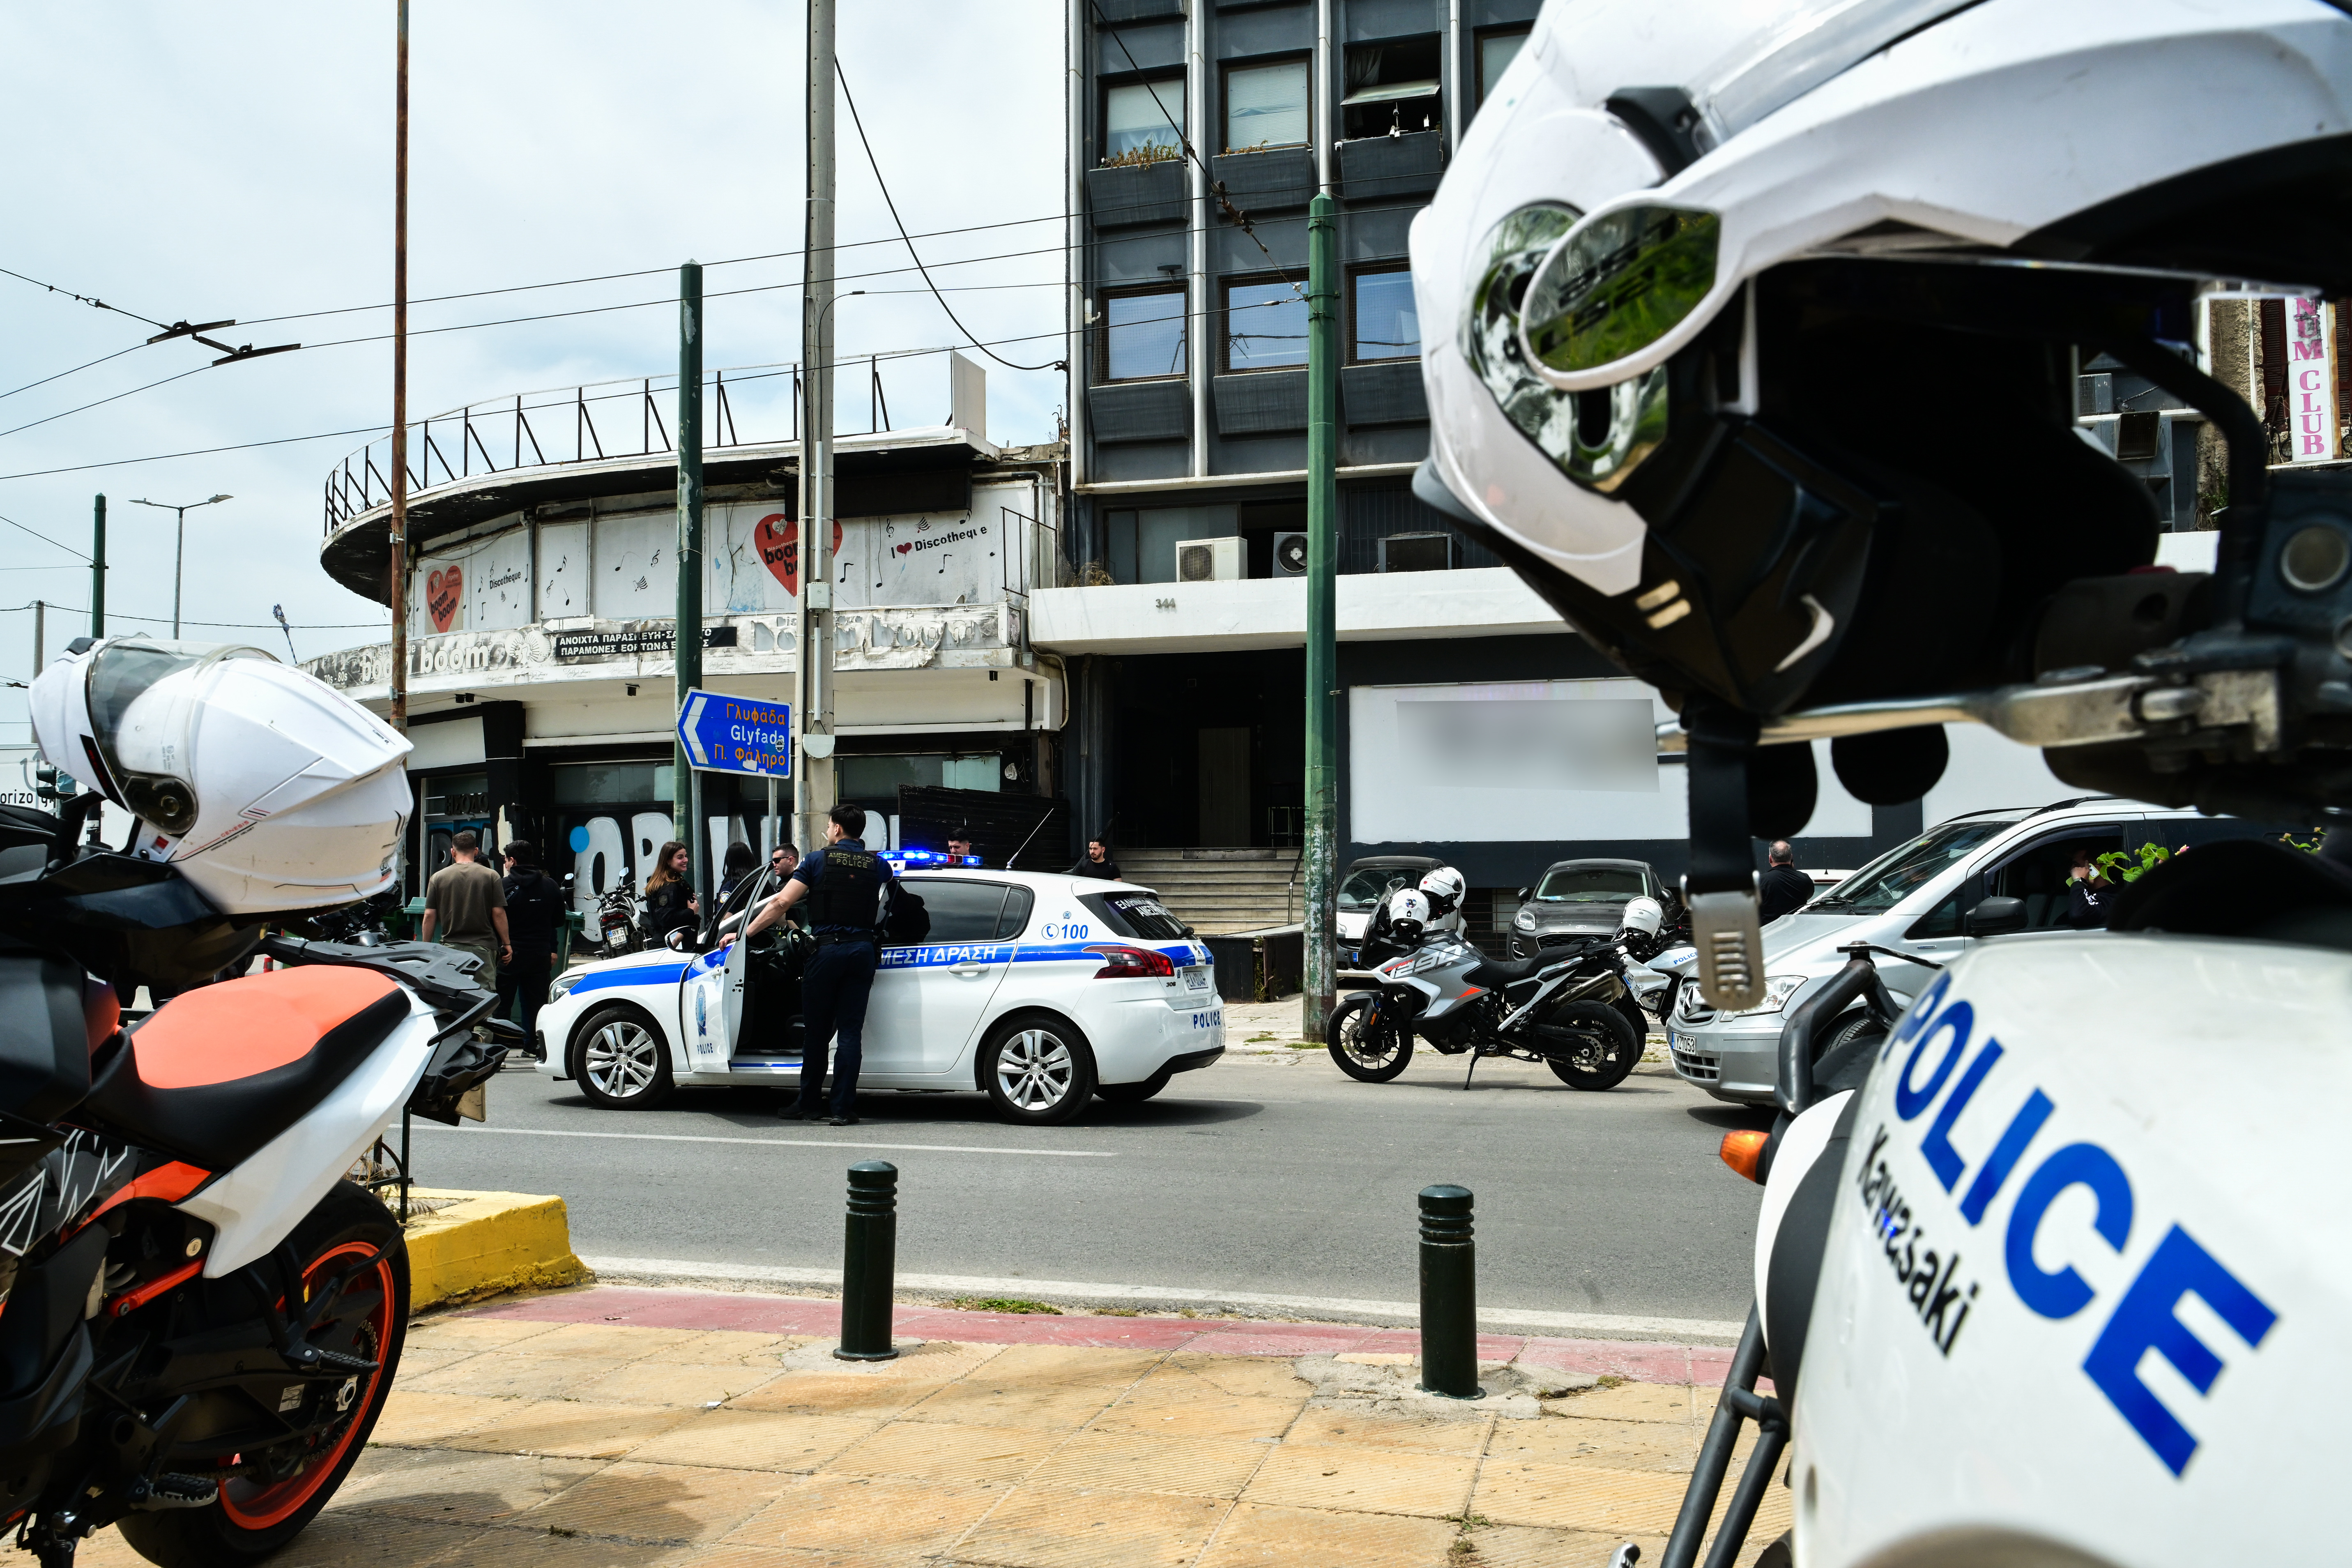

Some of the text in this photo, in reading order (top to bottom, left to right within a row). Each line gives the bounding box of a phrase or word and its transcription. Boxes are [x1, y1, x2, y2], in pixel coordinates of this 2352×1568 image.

[2299, 370, 2324, 455] CLUB
[765, 524, 772, 540] I
[767, 538, 798, 552] Discotheque
[891, 547, 895, 559] I
[430, 580, 434, 594] I
[490, 571, 521, 589] Discotheque
[430, 590, 448, 615] boom
[438, 597, 456, 622] boom
[1155, 598, 1176, 608] 344
[559, 635, 582, 645] ΑΝΟΙΧΤΑ
[561, 645, 617, 656] ΠΑΡΑΜΟΝΕΣ
[420, 646, 488, 674] boom
[324, 674, 333, 684] 70s
[338, 671, 348, 682] 80s
[727, 703, 785, 726] Γλυφάδα
[731, 725, 785, 745] Glyfada
[715, 744, 785, 769] Π. Φάληρο
[221, 820, 249, 838] GENESIS
[836, 859, 868, 868] POLICE
[853, 855, 874, 863] ΔΡΑΣΗ
[1062, 924, 1089, 939] 100
[881, 946, 998, 965] ΜΕΣΗ ΔΡΑΣΗ
[1390, 944, 1463, 979] 1290
[1673, 951, 1698, 965] POLICE
[1384, 958, 1414, 973] SUPER
[1417, 963, 1446, 976] ADVENTURE
[1193, 1011, 1220, 1029] POLICE
[697, 1043, 713, 1055] POLICE
[1882, 969, 2281, 1482] POLICE
[1857, 1123, 1980, 1359] Kawasaki
